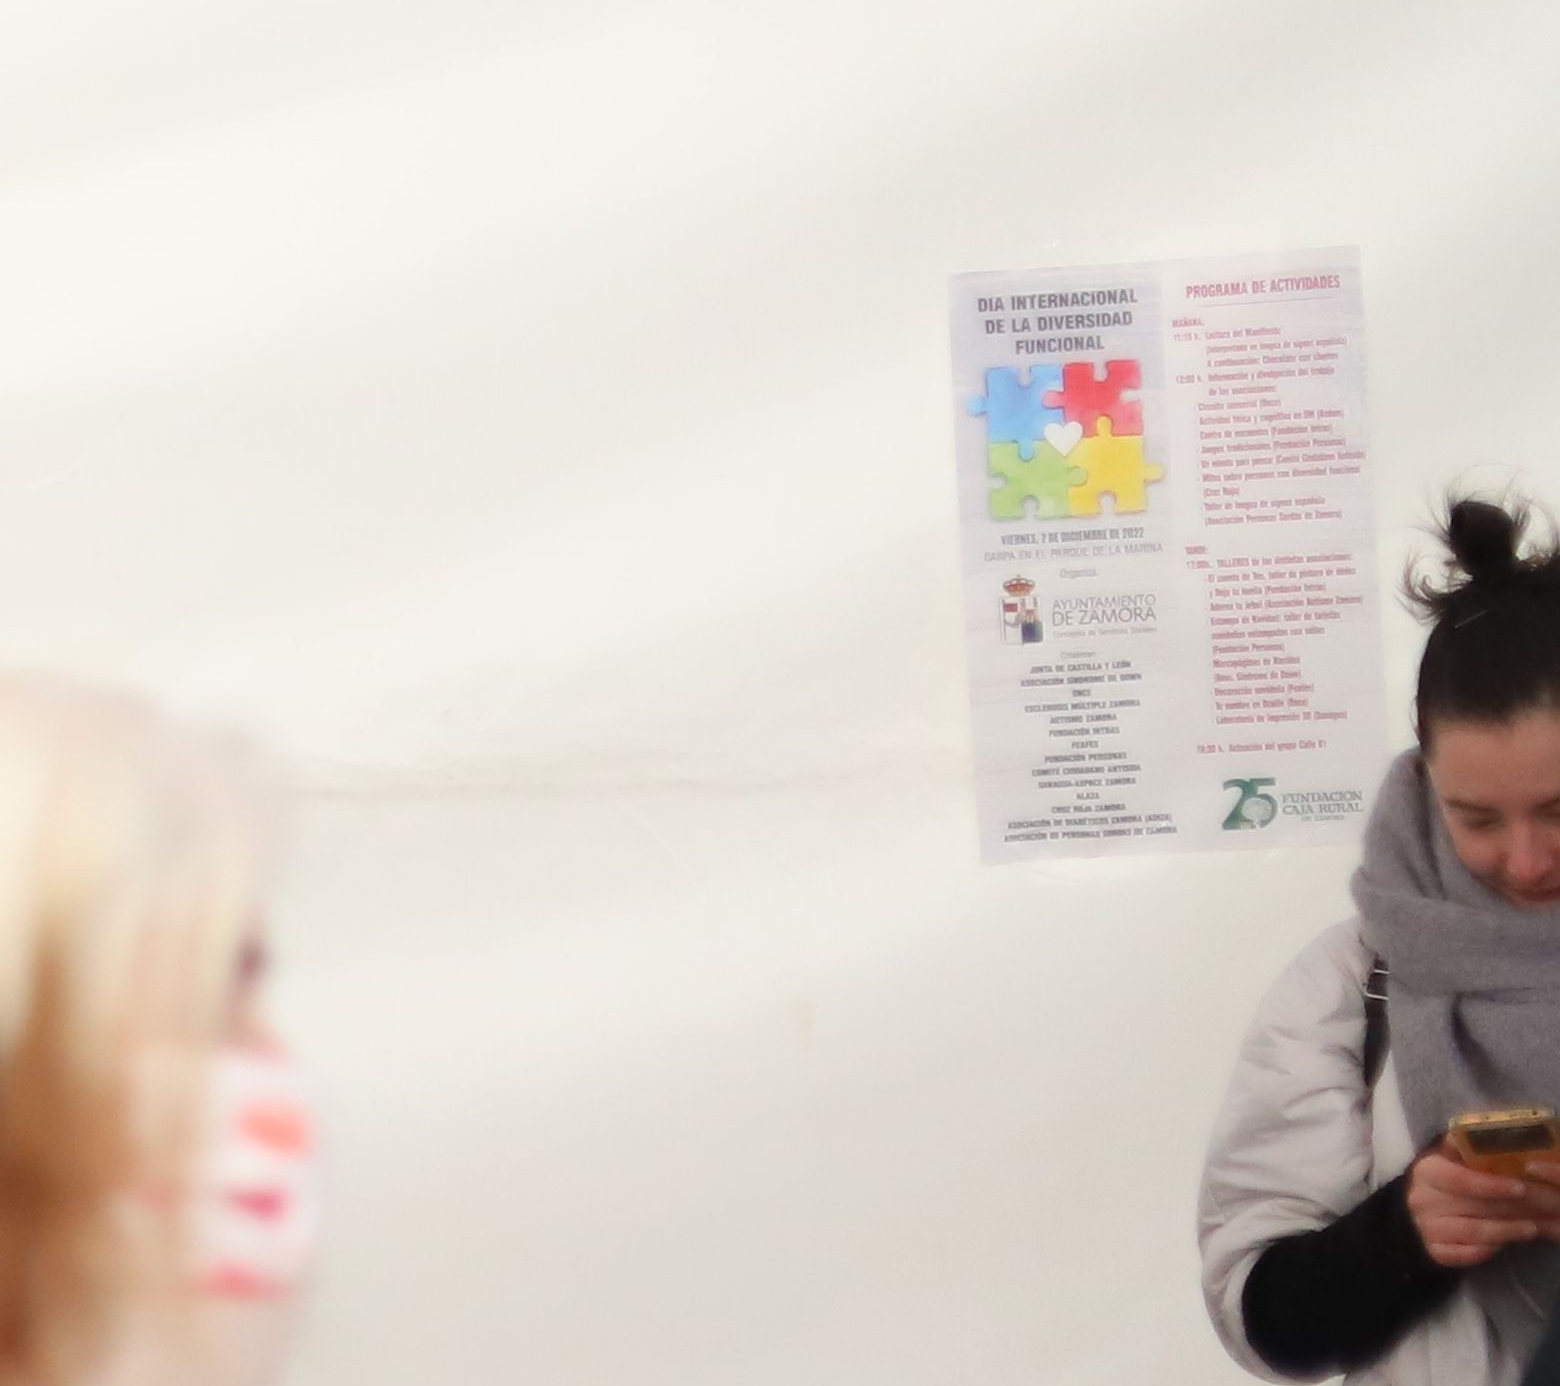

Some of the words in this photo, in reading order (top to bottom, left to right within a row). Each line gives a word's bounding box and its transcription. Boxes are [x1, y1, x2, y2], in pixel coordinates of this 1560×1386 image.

[1186, 284, 1248, 299] PROGRAMA
[1252, 281, 1266, 294] DE
[1270, 275, 1340, 292] ACTIVIDADES
[978, 298, 1004, 312] DIA
[1012, 288, 1137, 310] INTERNACIONAL
[985, 319, 1005, 334] DE
[1012, 318, 1031, 333] LA
[1038, 312, 1132, 331] DIVERSIDAD
[1015, 336, 1105, 355] FUNCIONAL
[1052, 594, 1157, 610] AYUNTAMIENTO
[1052, 612, 1075, 626] DE
[1079, 608, 1157, 625] ZAMORA
[1222, 777, 1278, 831] 25
[1282, 804, 1313, 815] CAJA
[1319, 802, 1363, 813] RURAL
